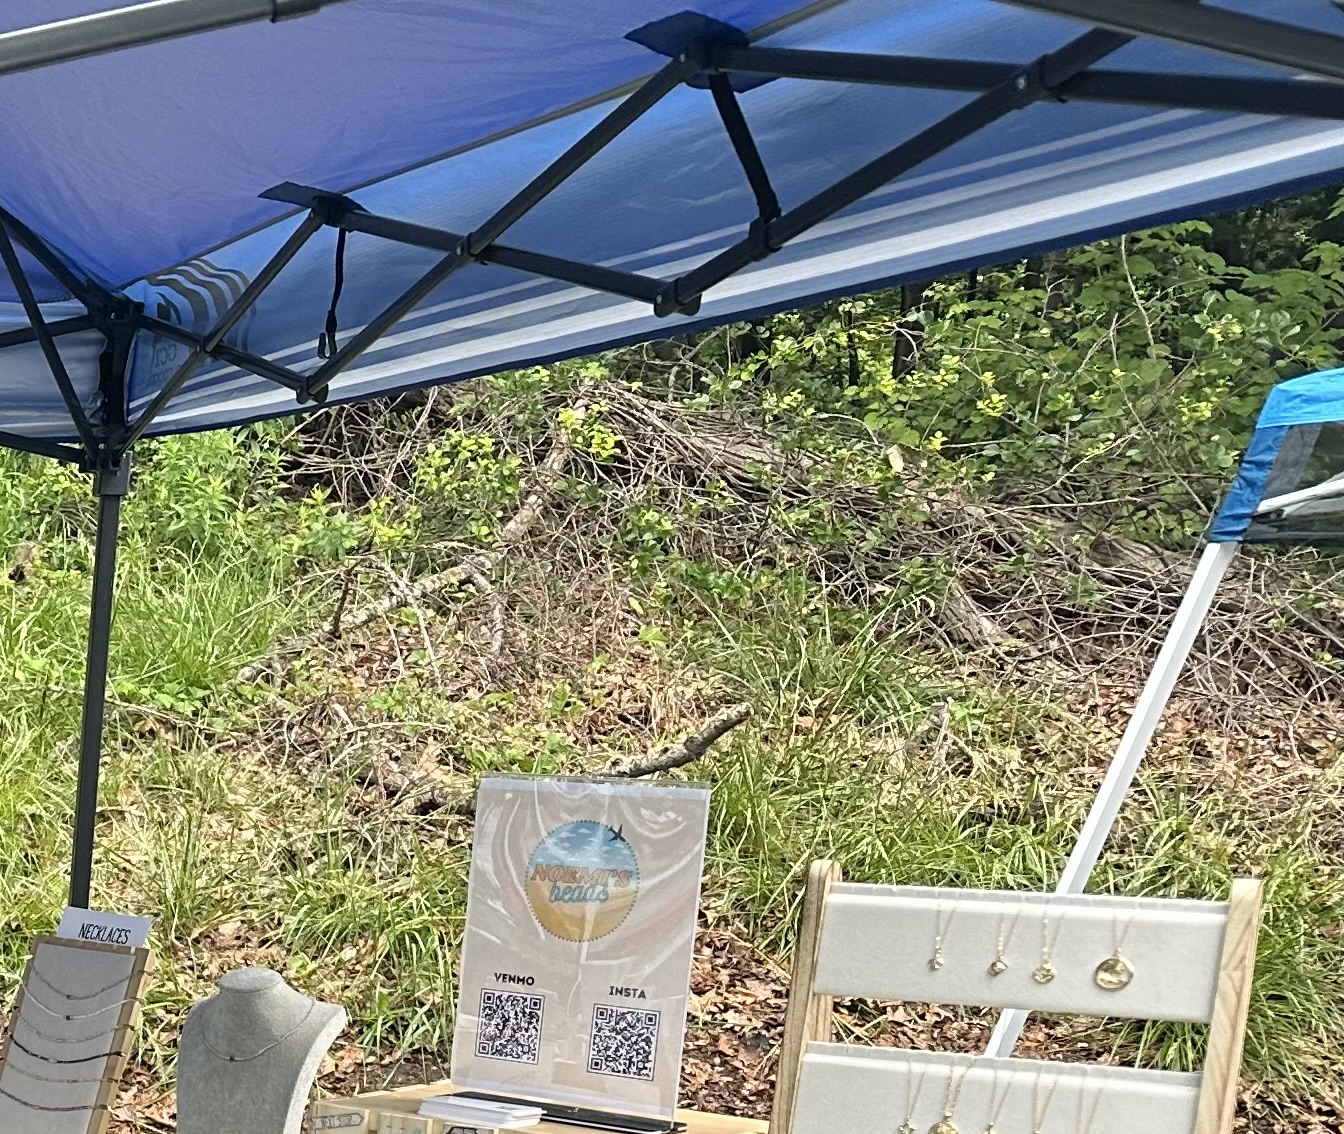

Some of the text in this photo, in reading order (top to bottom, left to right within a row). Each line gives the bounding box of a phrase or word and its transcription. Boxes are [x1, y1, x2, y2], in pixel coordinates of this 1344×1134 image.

[78, 922, 131, 945] NECKLACES
[494, 972, 535, 986] VENMO
[609, 986, 647, 1000] INSTA
